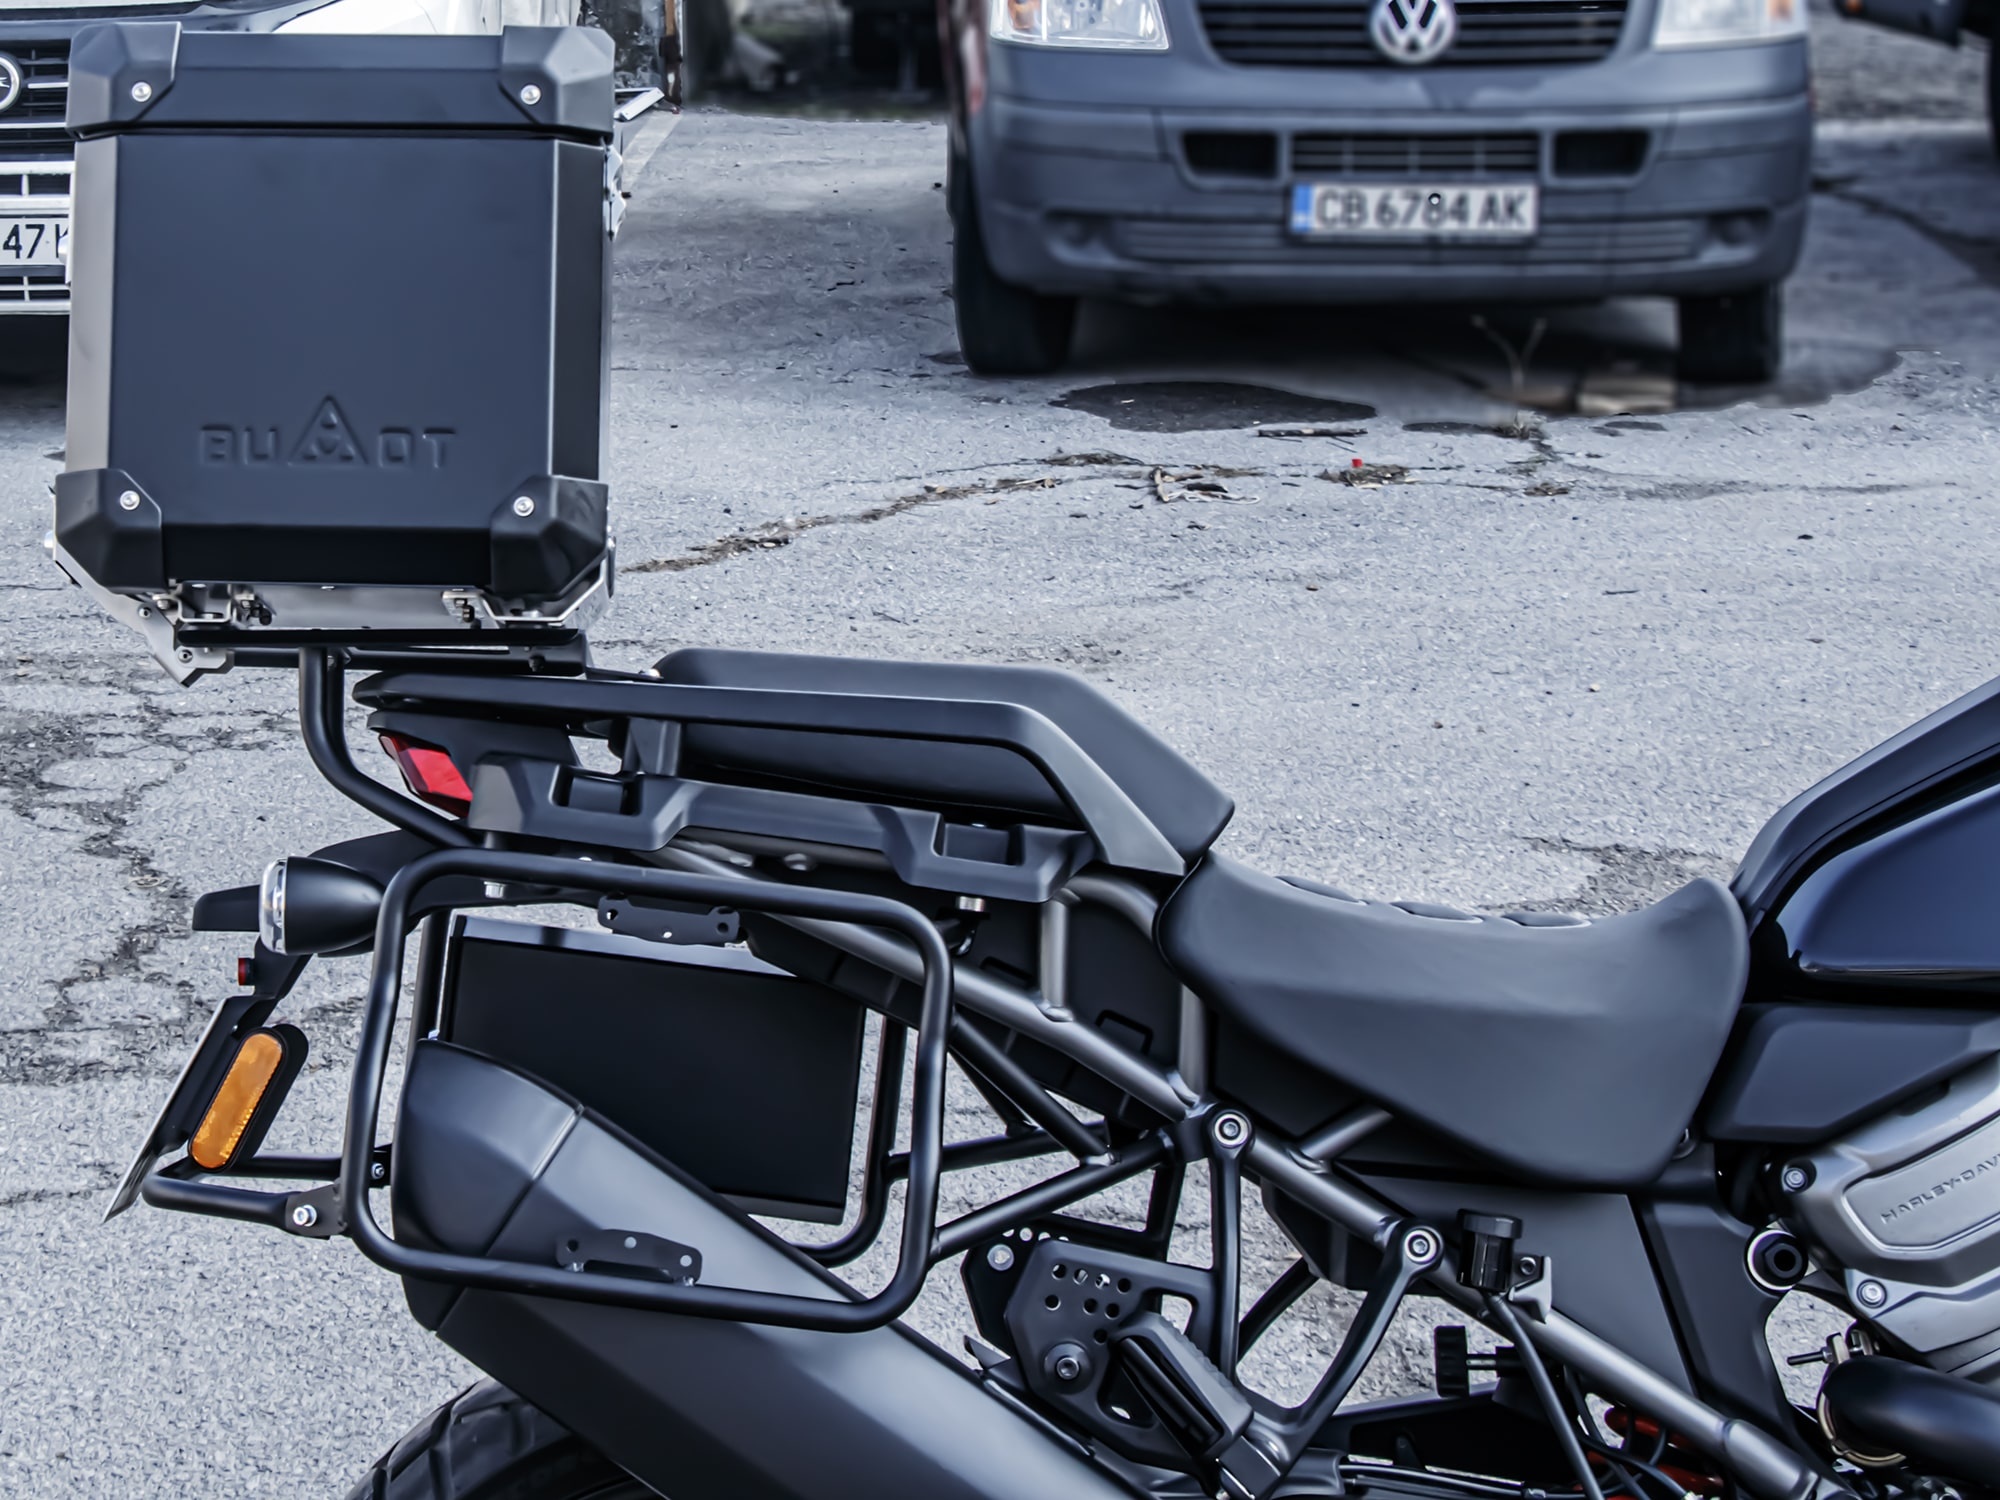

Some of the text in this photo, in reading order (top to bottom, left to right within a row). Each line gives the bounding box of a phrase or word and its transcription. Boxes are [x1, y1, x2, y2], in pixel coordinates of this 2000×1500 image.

[1316, 188, 1527, 229] CB 6784 AK
[1880, 1153, 2000, 1225] HARLEY-DAV
